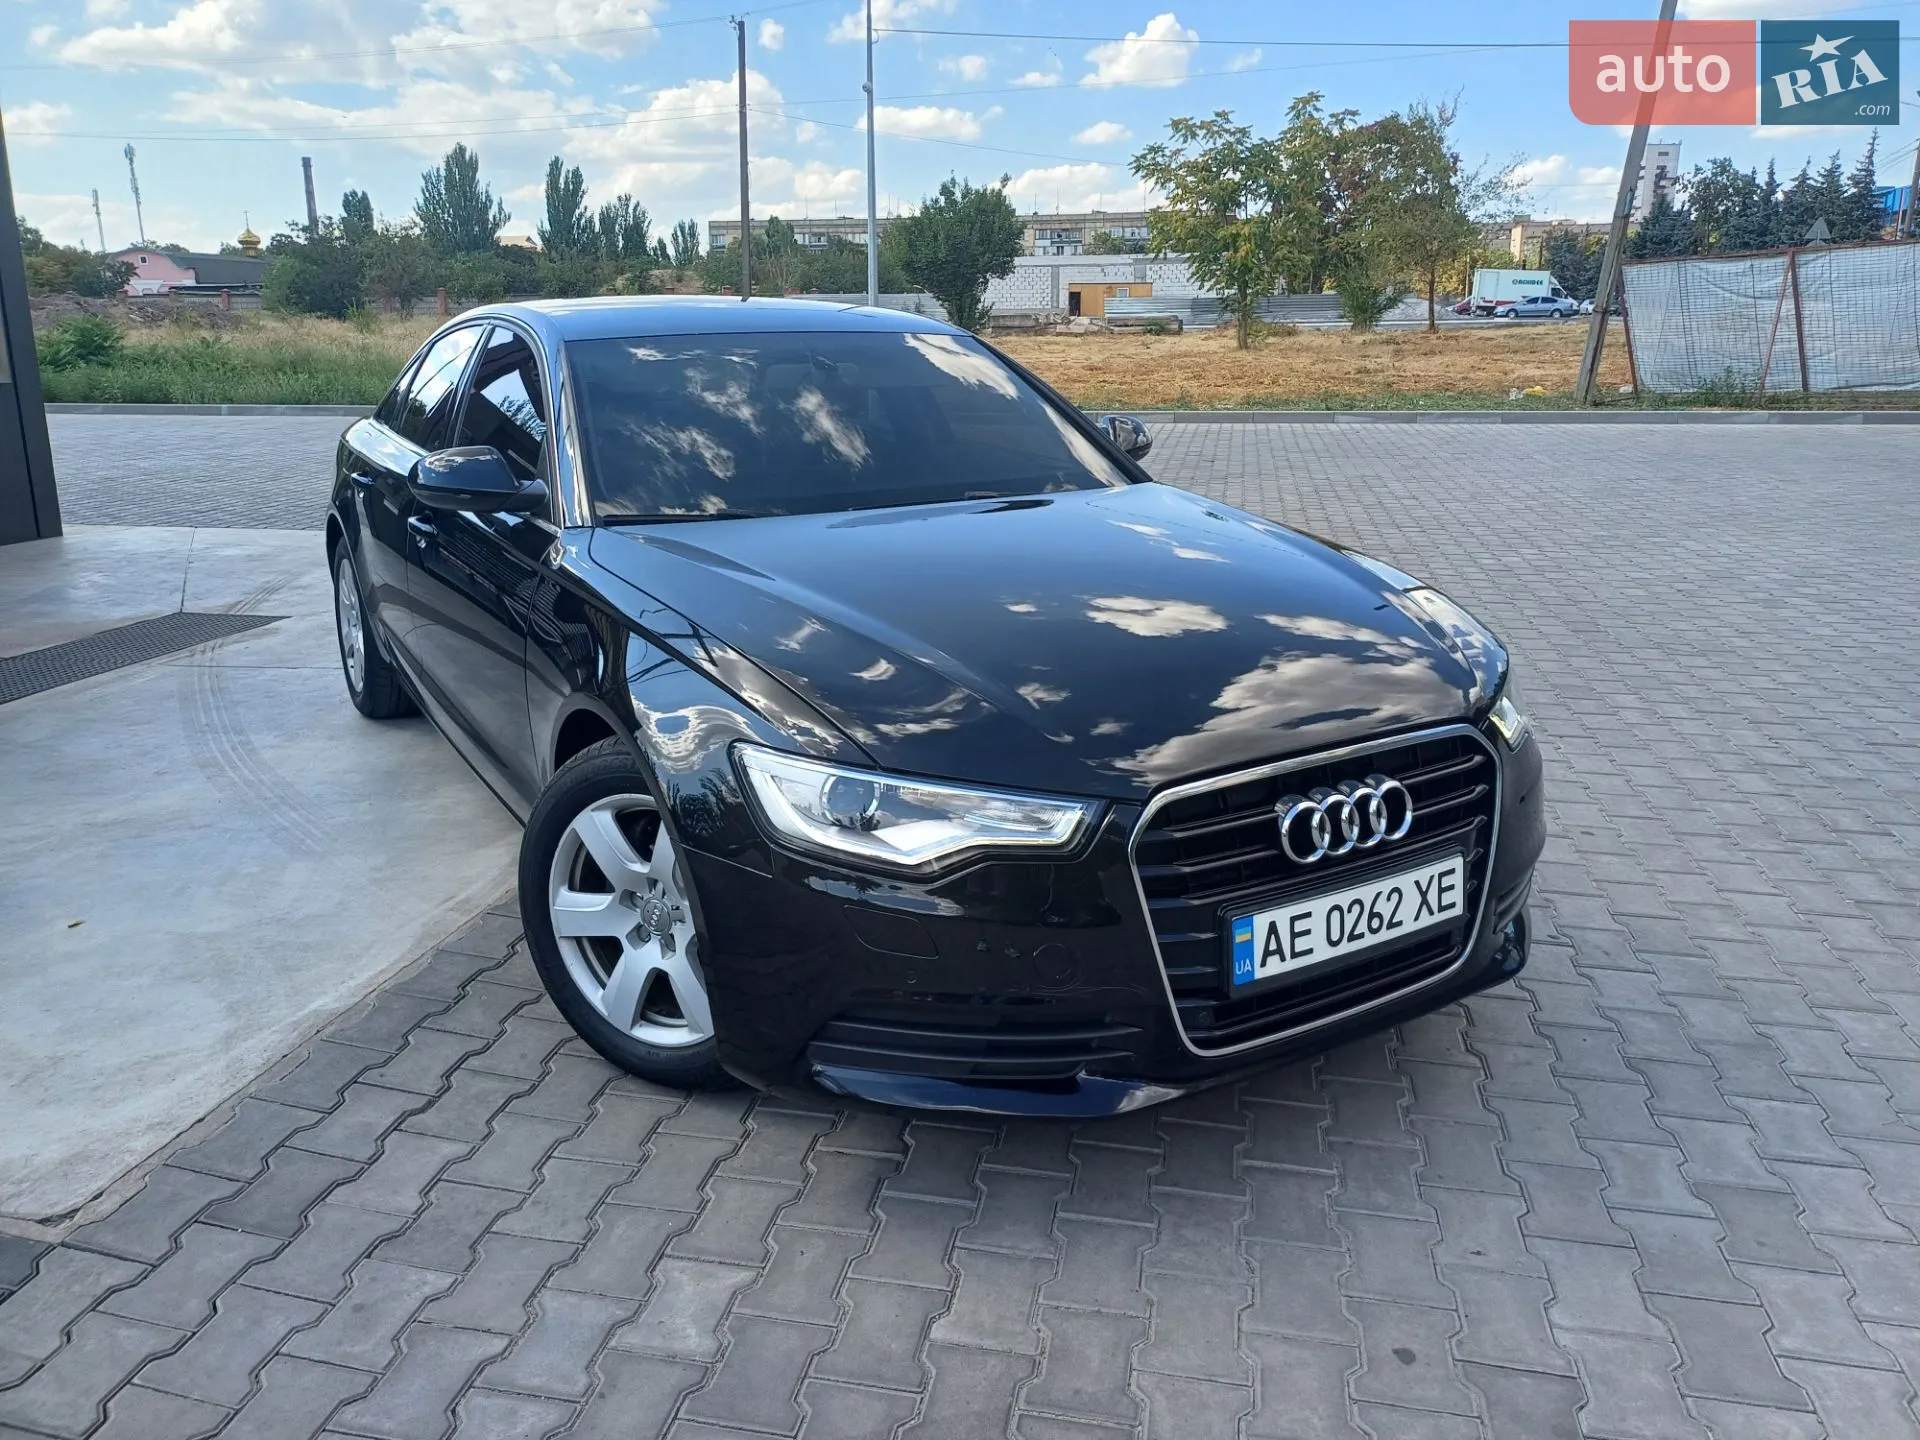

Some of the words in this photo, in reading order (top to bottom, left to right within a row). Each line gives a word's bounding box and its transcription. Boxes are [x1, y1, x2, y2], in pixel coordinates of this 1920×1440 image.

[1260, 911, 1313, 968] AE
[1326, 887, 1404, 948] 0262
[1414, 868, 1456, 921] XE
[1235, 959, 1252, 974] UA
